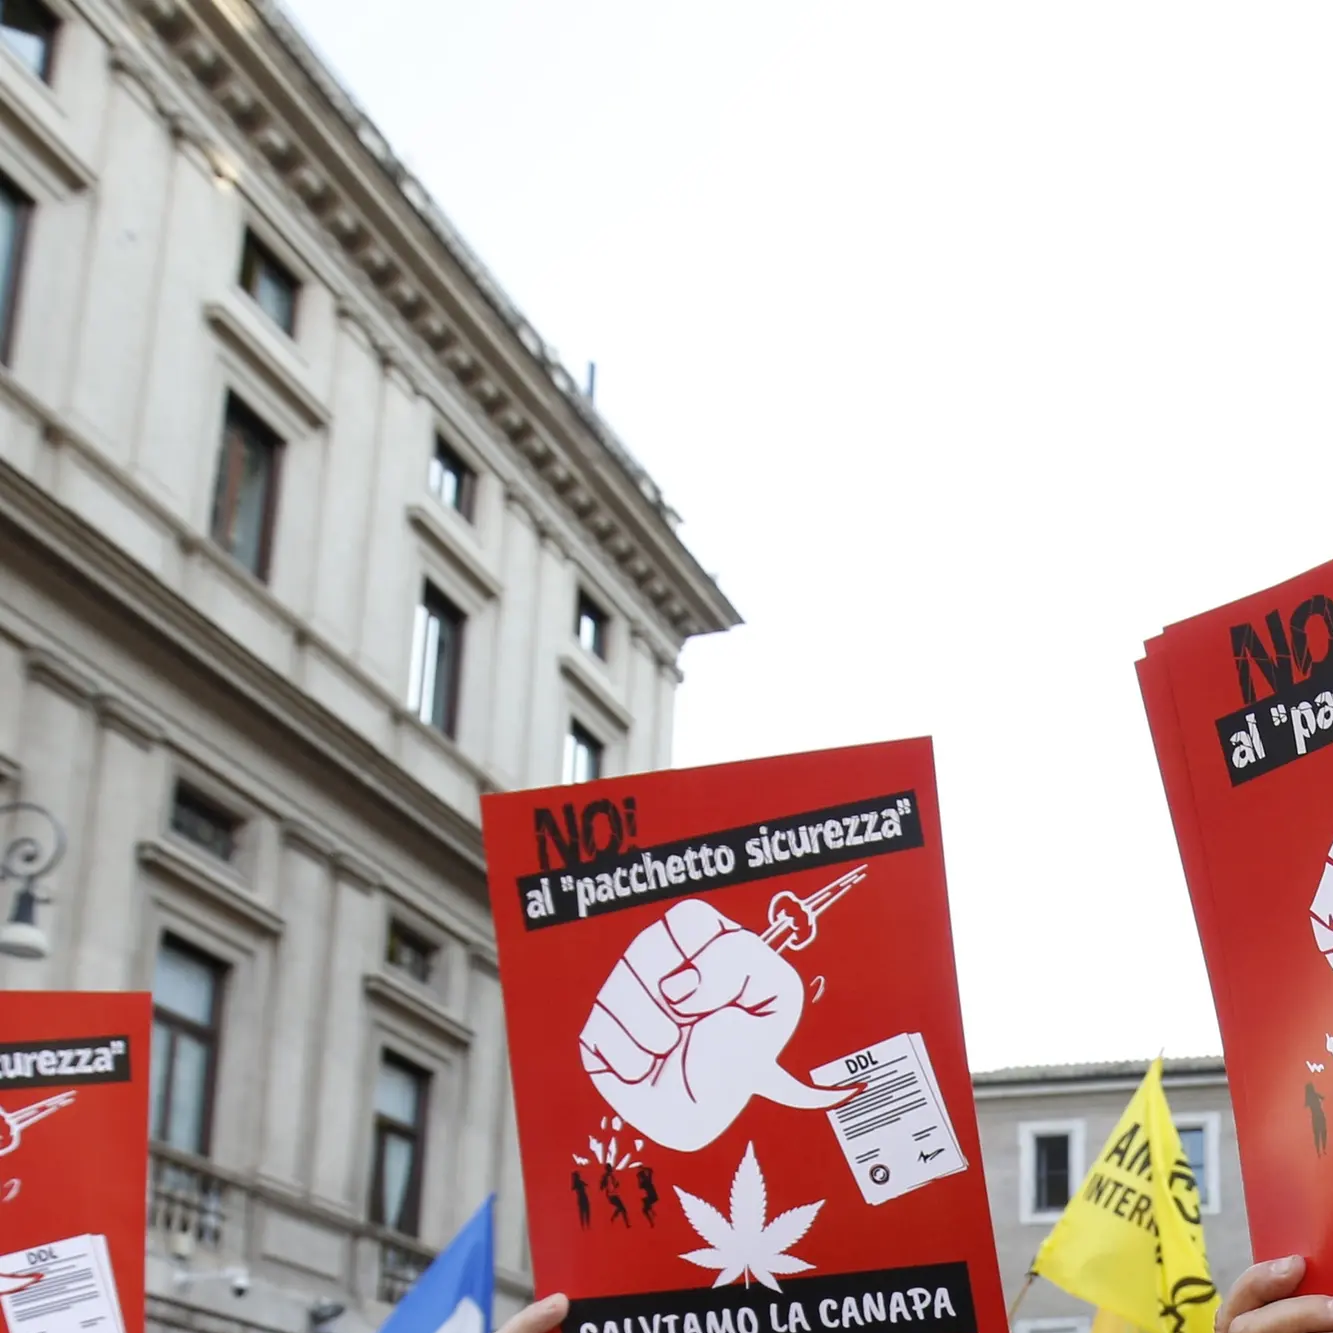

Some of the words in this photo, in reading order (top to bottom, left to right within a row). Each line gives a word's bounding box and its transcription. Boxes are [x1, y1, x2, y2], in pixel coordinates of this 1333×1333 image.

[1230, 714, 1268, 771] al
[533, 797, 637, 872] NO!
[526, 876, 555, 921] al
[560, 842, 735, 918] "pacchetto
[745, 798, 913, 868] sicurezza"
[0, 1040, 126, 1080] urezza"
[846, 1050, 878, 1076] DDL
[27, 1245, 58, 1266] DDL
[769, 1301, 811, 1333] LA
[819, 1286, 956, 1330] CANAPA
